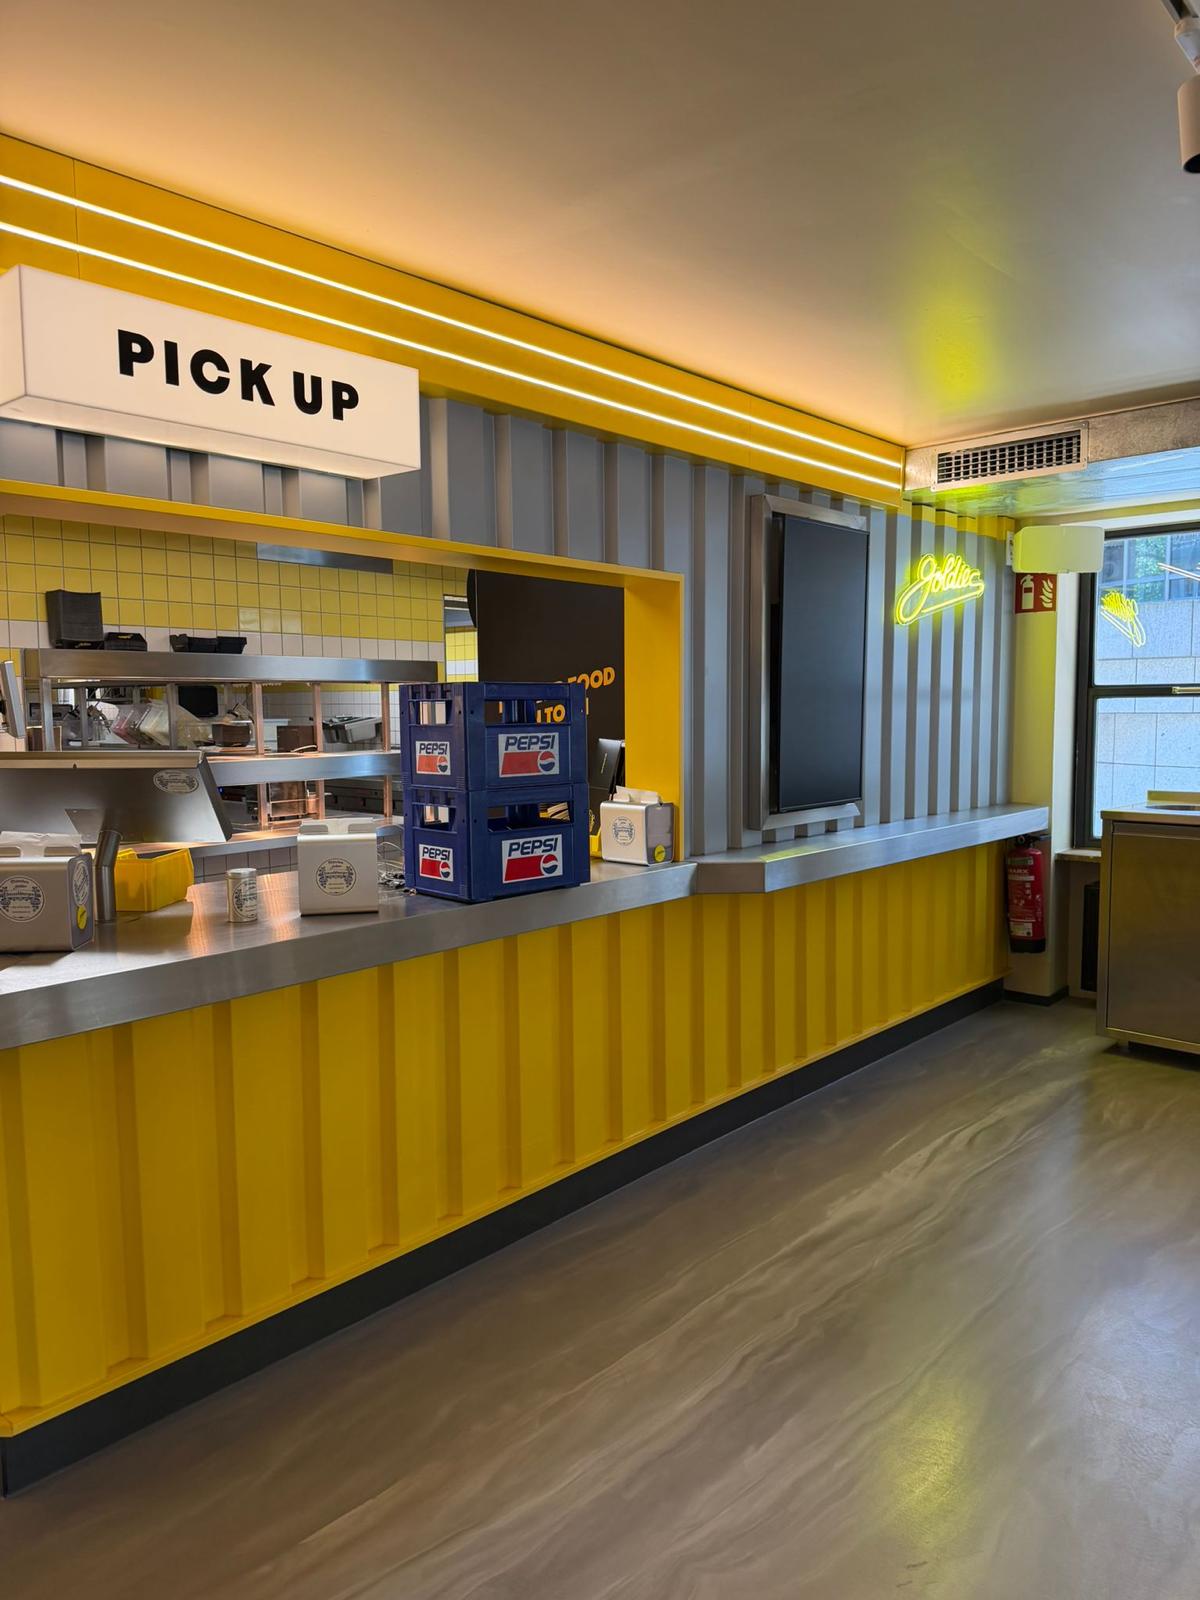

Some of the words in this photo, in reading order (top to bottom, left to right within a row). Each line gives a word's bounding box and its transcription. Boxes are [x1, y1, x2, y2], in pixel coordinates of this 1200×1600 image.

[118, 329, 275, 406] PICK
[293, 371, 359, 421] UP
[419, 743, 448, 755] PEPSI
[505, 735, 556, 751] PEPSI
[422, 847, 450, 861] PEPSI
[508, 838, 558, 857] PEPSI
